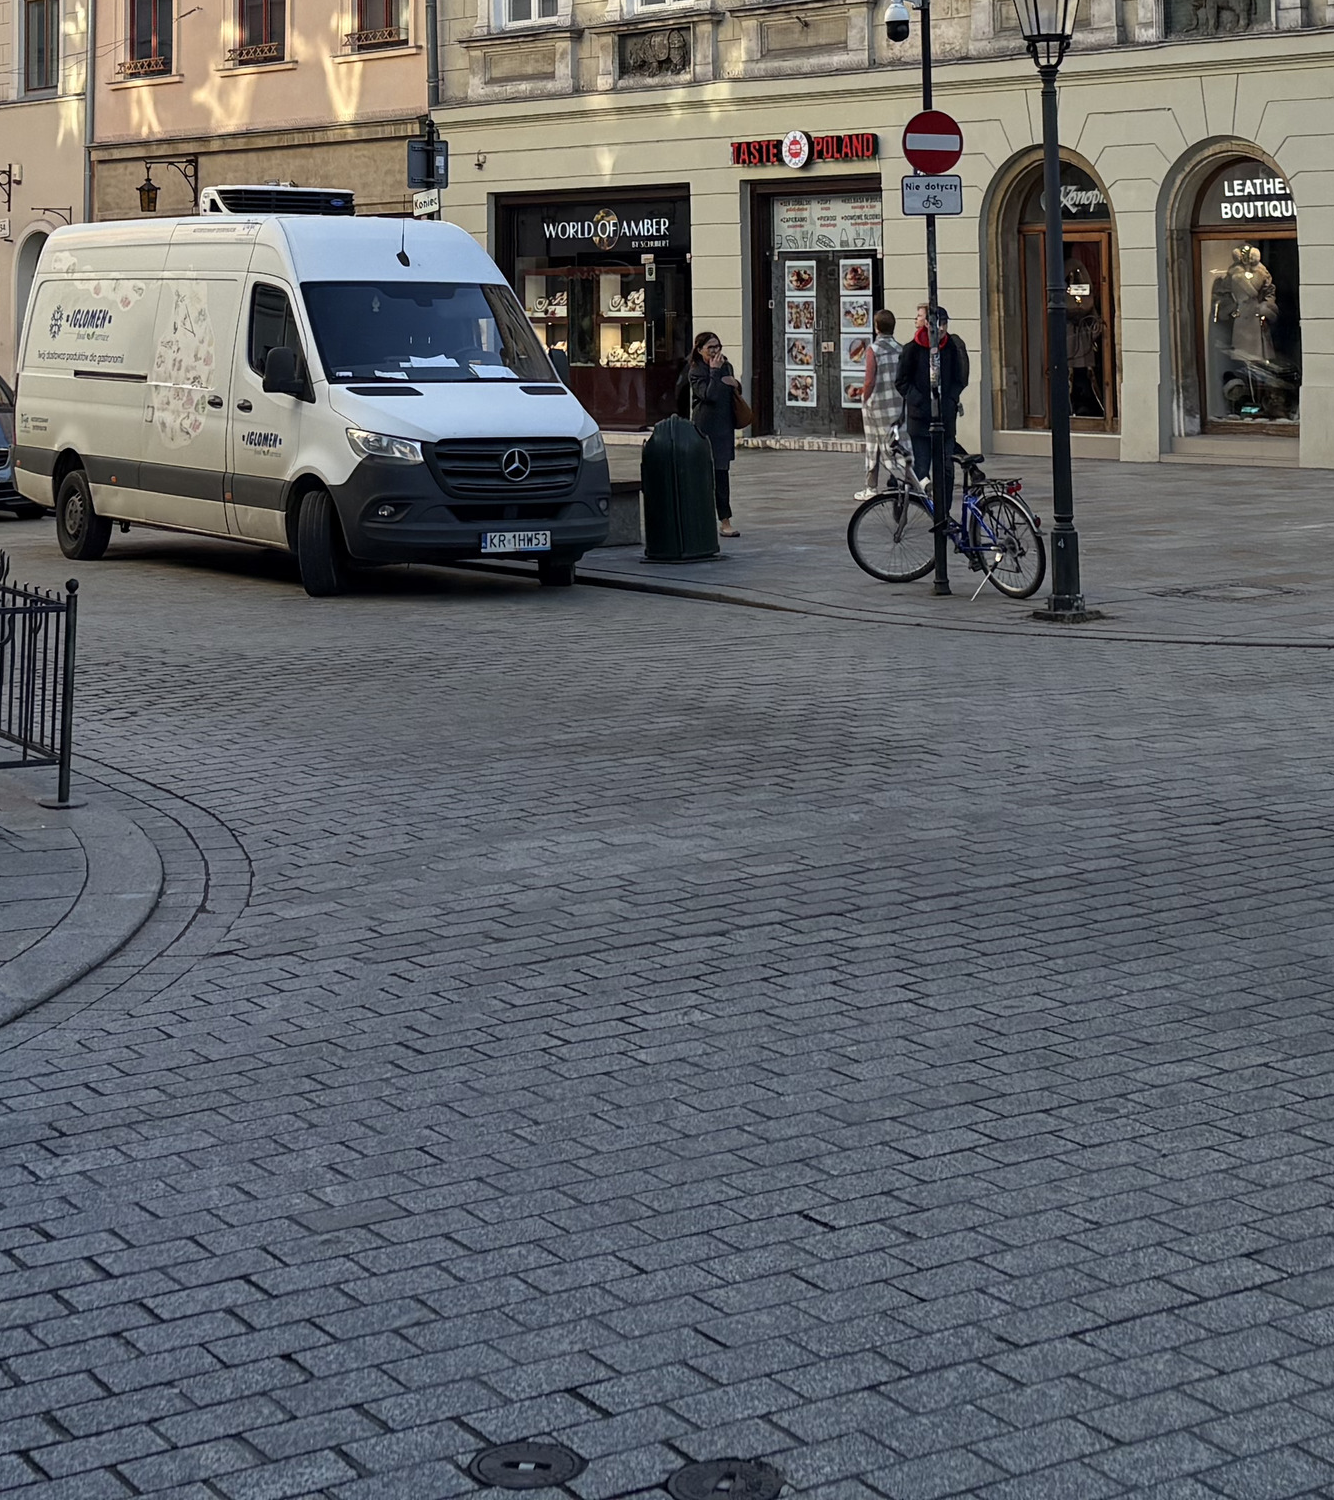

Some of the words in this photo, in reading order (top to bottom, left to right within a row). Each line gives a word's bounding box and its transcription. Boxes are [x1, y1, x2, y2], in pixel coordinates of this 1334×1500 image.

[731, 140, 777, 164] TASTE
[814, 133, 873, 160] POLAND
[905, 181, 920, 191] Nie
[925, 182, 957, 192] dotyczy
[414, 195, 438, 211] Koniec
[543, 221, 594, 239] WORLD
[598, 220, 618, 238] OF
[620, 218, 670, 237] AMBER
[489, 534, 507, 548] KR
[512, 532, 548, 548] 1HW53
